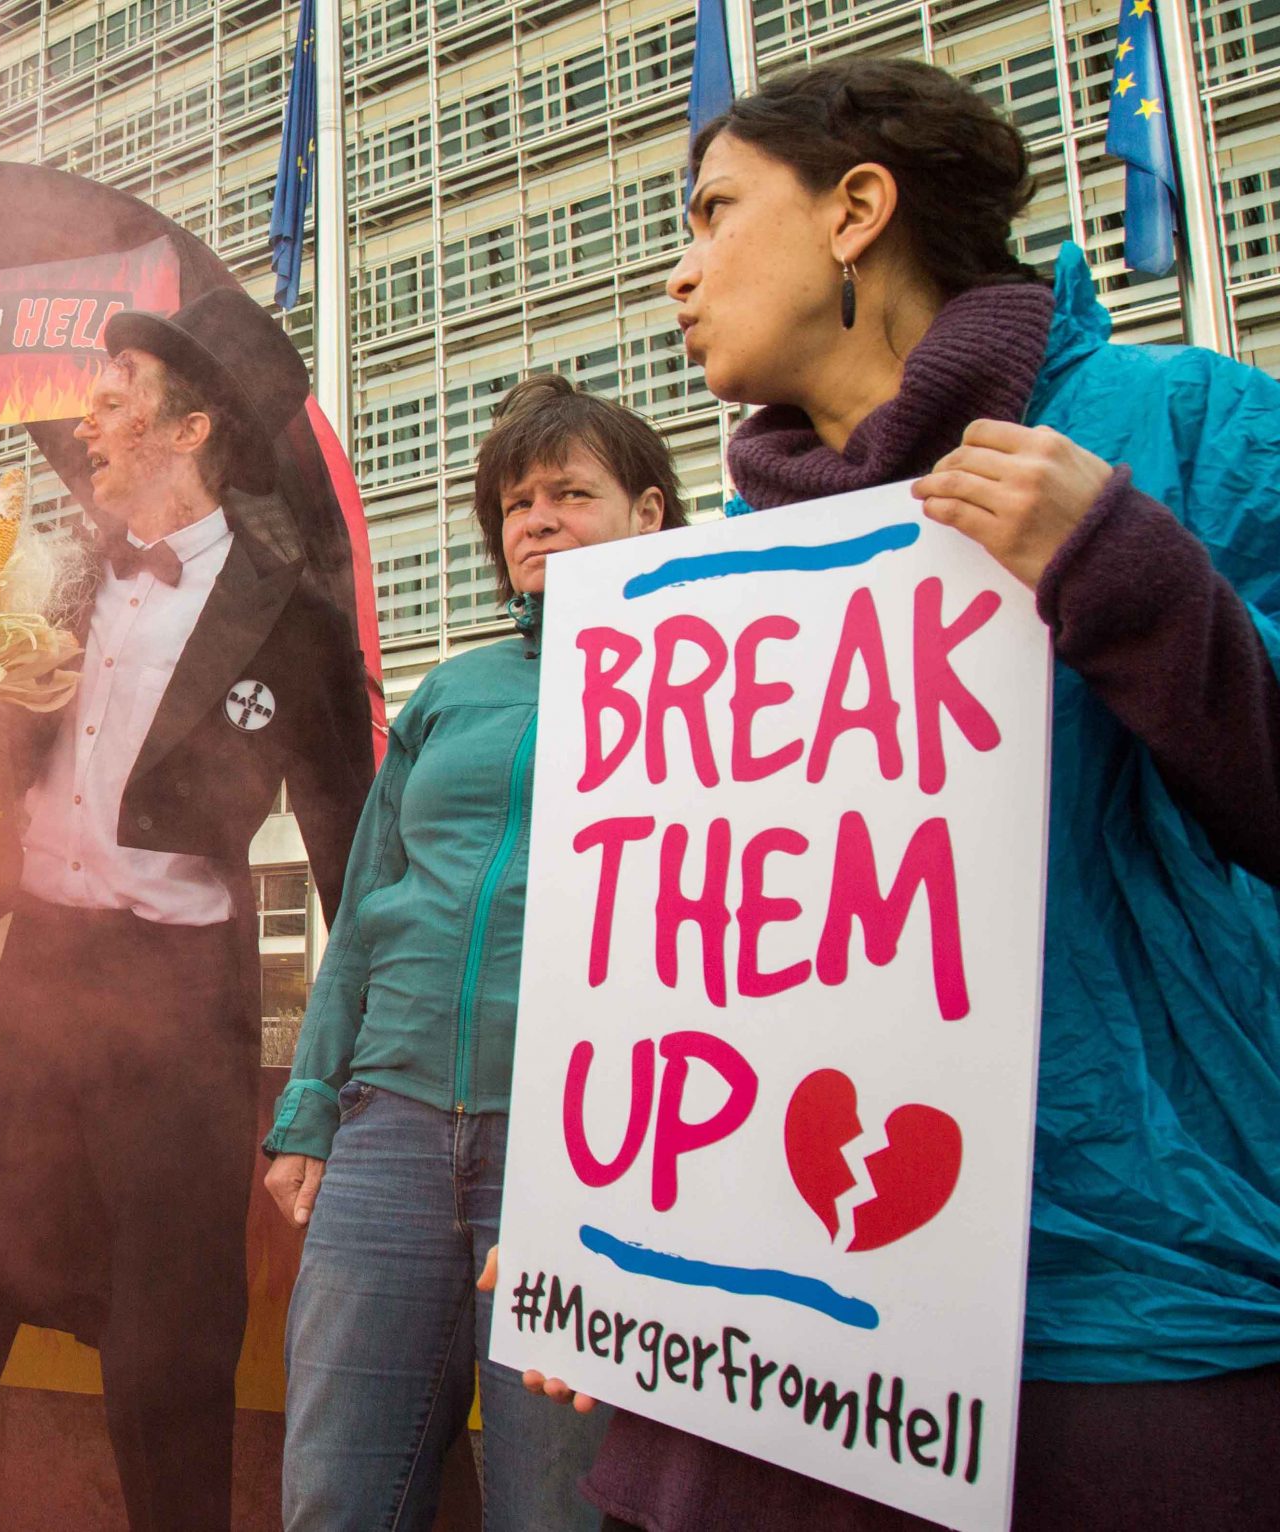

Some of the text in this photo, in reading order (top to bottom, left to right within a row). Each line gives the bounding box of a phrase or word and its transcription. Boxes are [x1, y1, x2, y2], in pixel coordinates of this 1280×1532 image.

[576, 576, 1002, 795] BREAK
[573, 810, 970, 1022] THEM
[563, 1030, 758, 1212] UP
